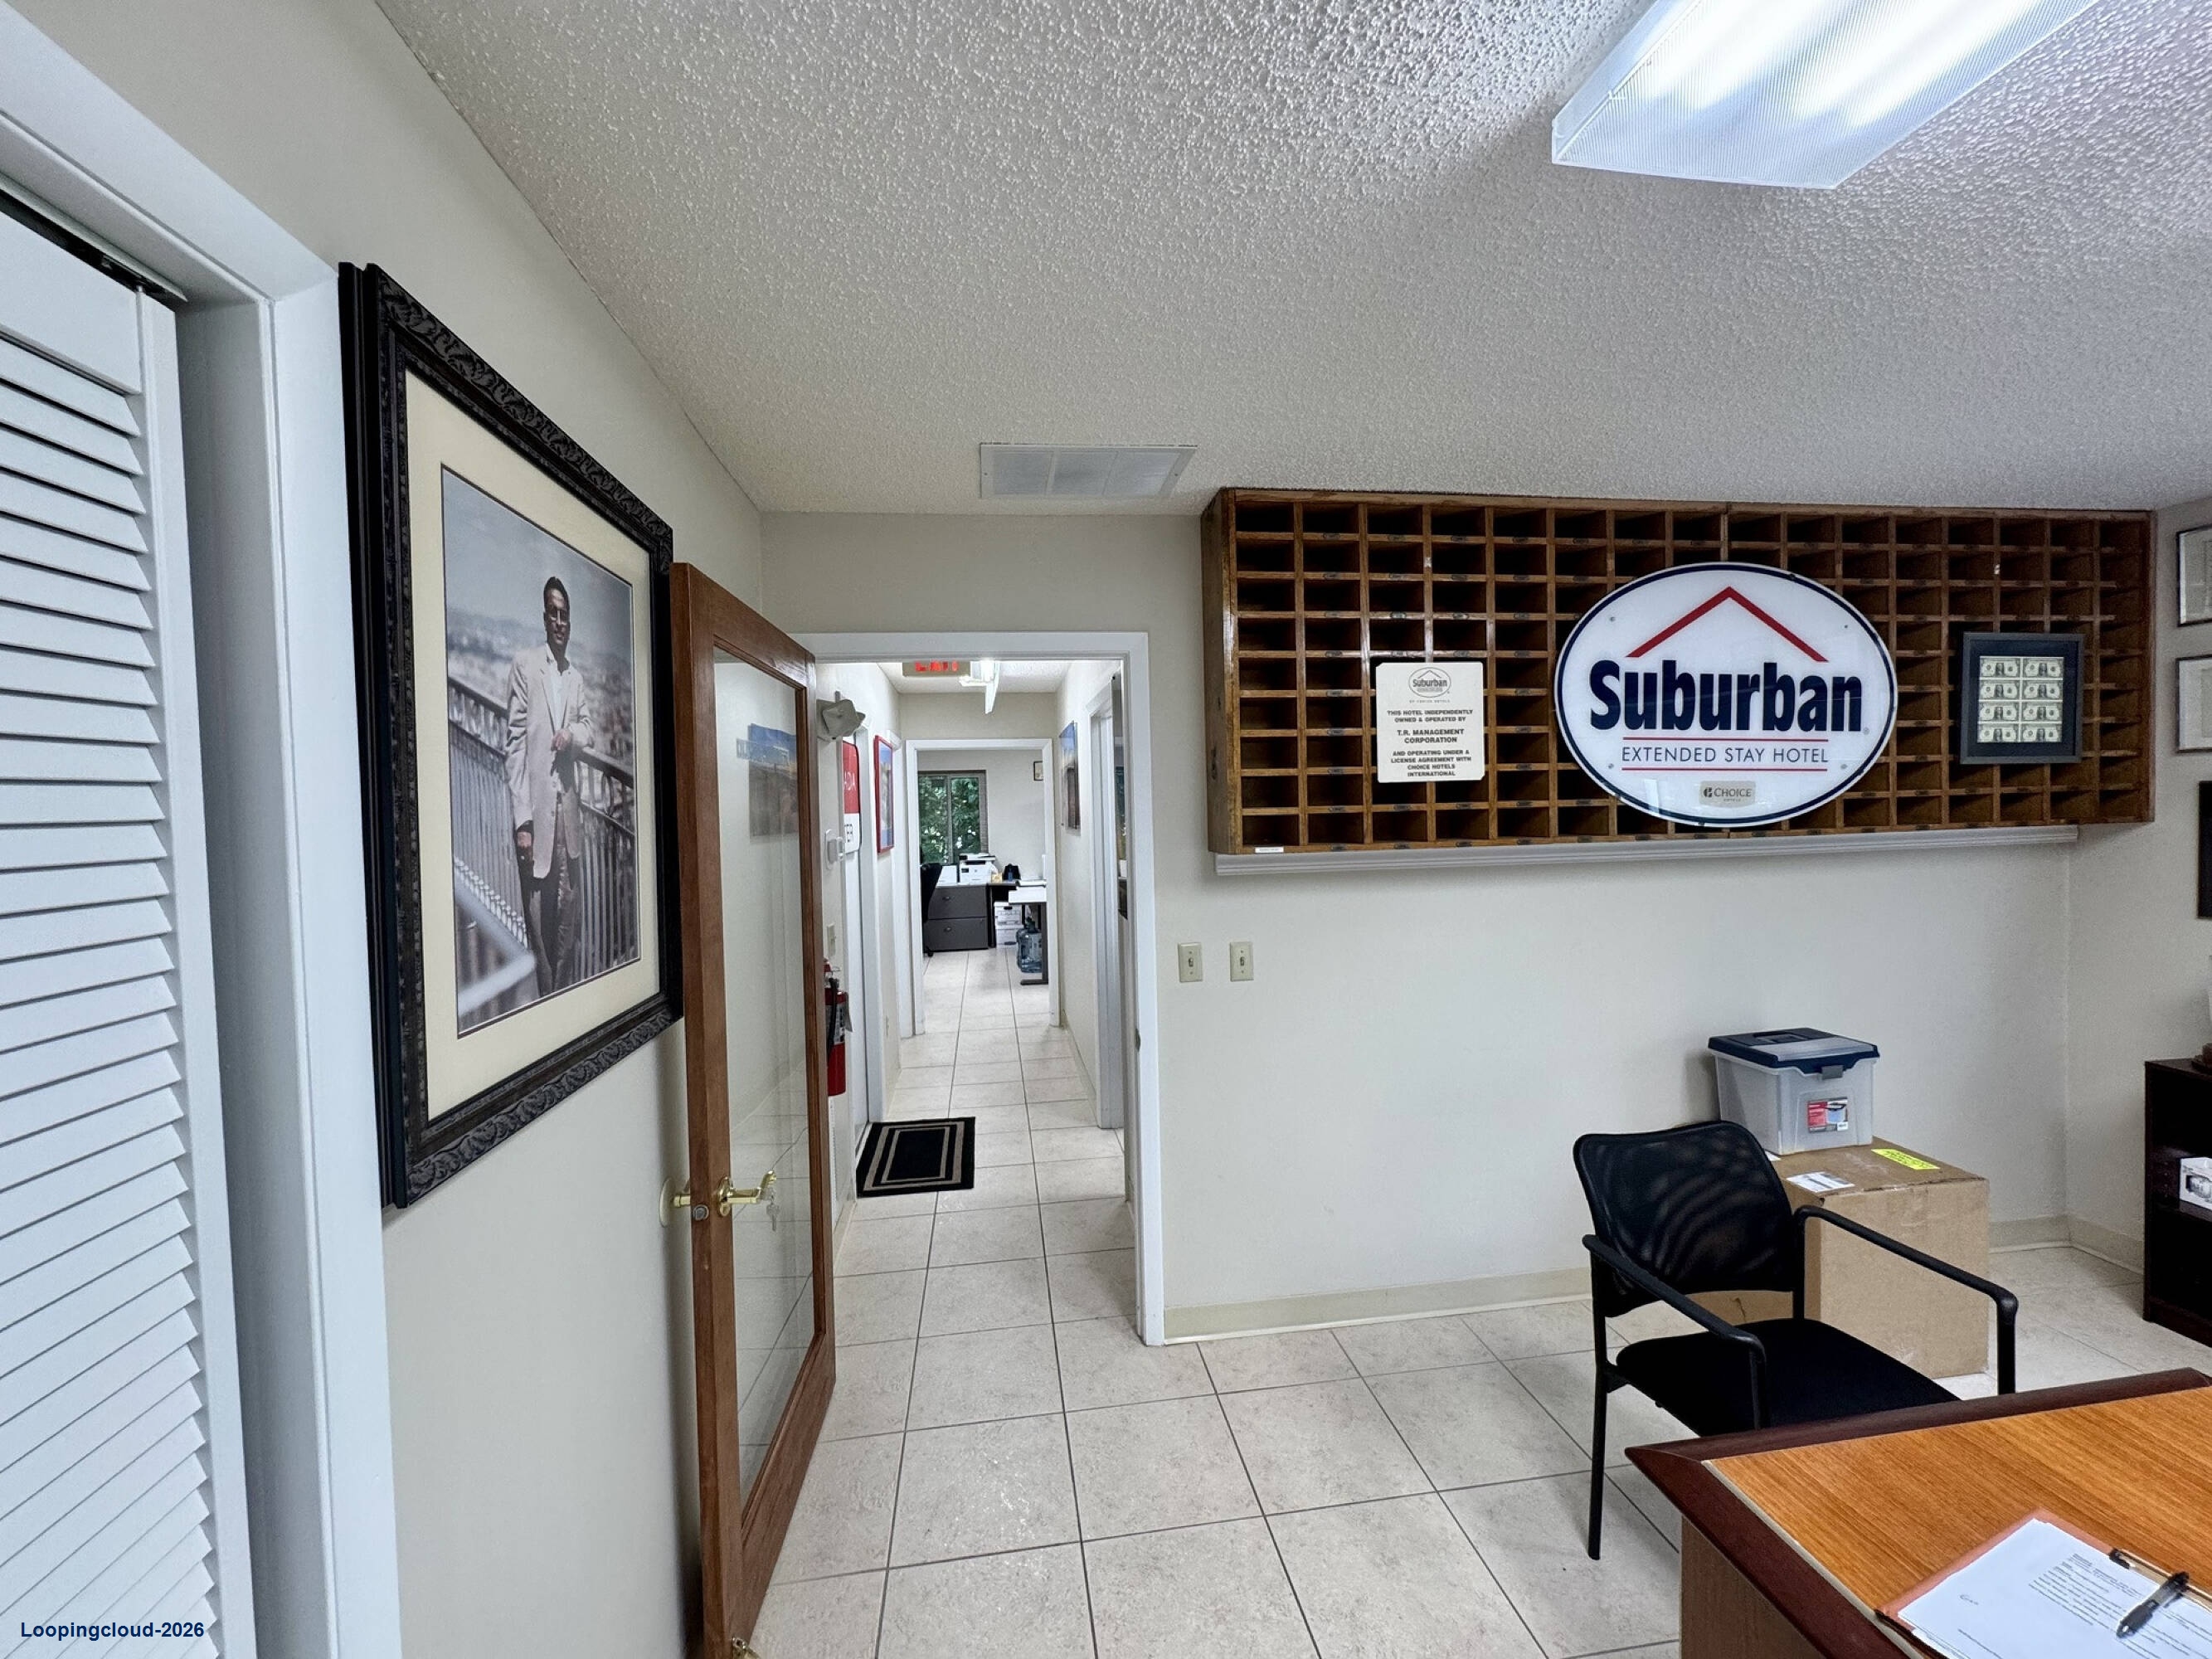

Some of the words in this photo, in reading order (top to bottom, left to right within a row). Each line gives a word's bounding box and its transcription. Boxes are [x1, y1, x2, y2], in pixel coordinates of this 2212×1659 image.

[1412, 679, 1447, 687] Suburban
[1589, 659, 1862, 732] Suburban
[1621, 747, 1716, 761] EXTENDED
[1724, 747, 1765, 762] STAY
[1773, 748, 1829, 763] HOTEL
[1714, 787, 1753, 797] CHOICE
